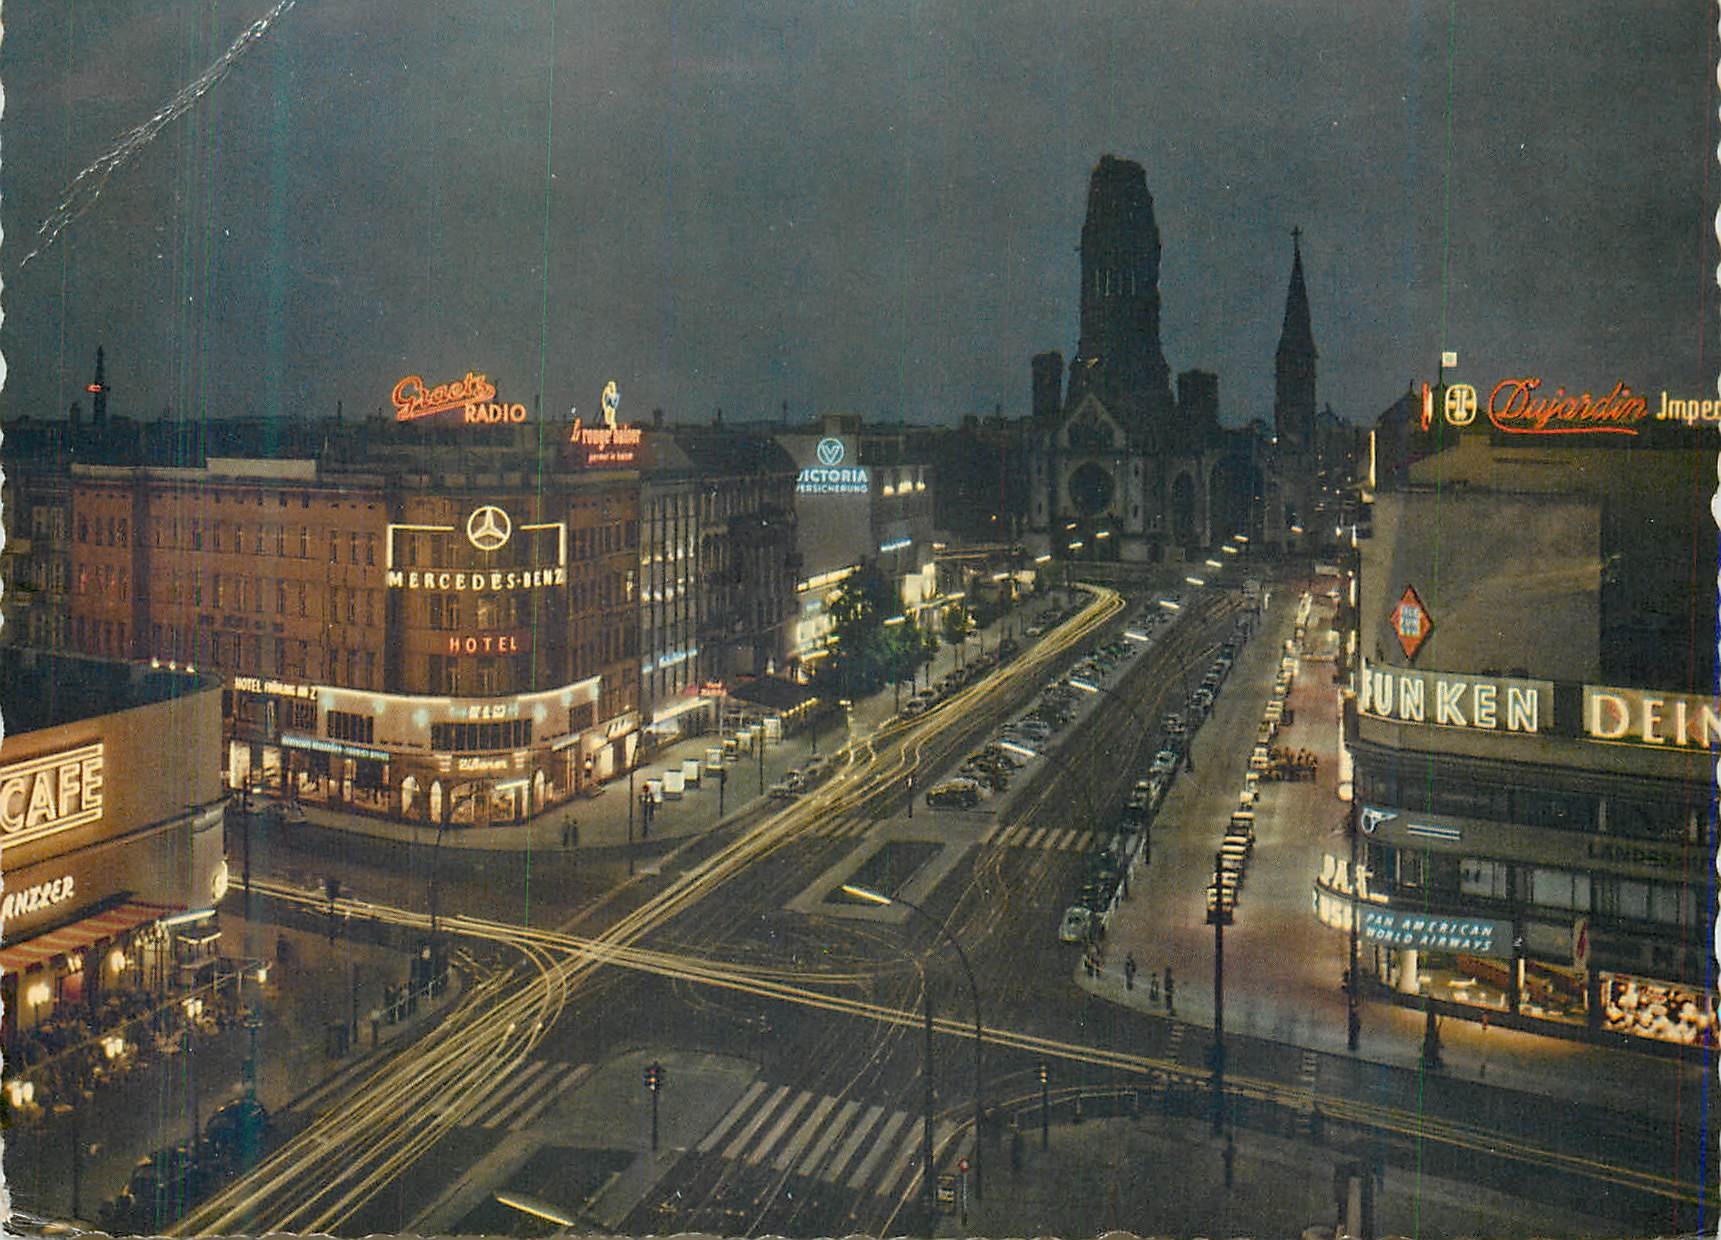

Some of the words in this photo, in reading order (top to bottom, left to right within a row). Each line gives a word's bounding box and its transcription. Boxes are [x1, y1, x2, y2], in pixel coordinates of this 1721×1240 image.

[464, 403, 526, 423] RADIO
[1488, 377, 1650, 434] Dujardin
[386, 567, 565, 590] MERCEDES-BENZ
[448, 636, 518, 654] HOTEL
[234, 677, 261, 693] HOTEL
[1366, 913, 1394, 928] PAN
[1402, 919, 1494, 936] AMERICAN
[1366, 928, 1413, 943] WORLD
[1420, 934, 1493, 951] AIRWAYS
